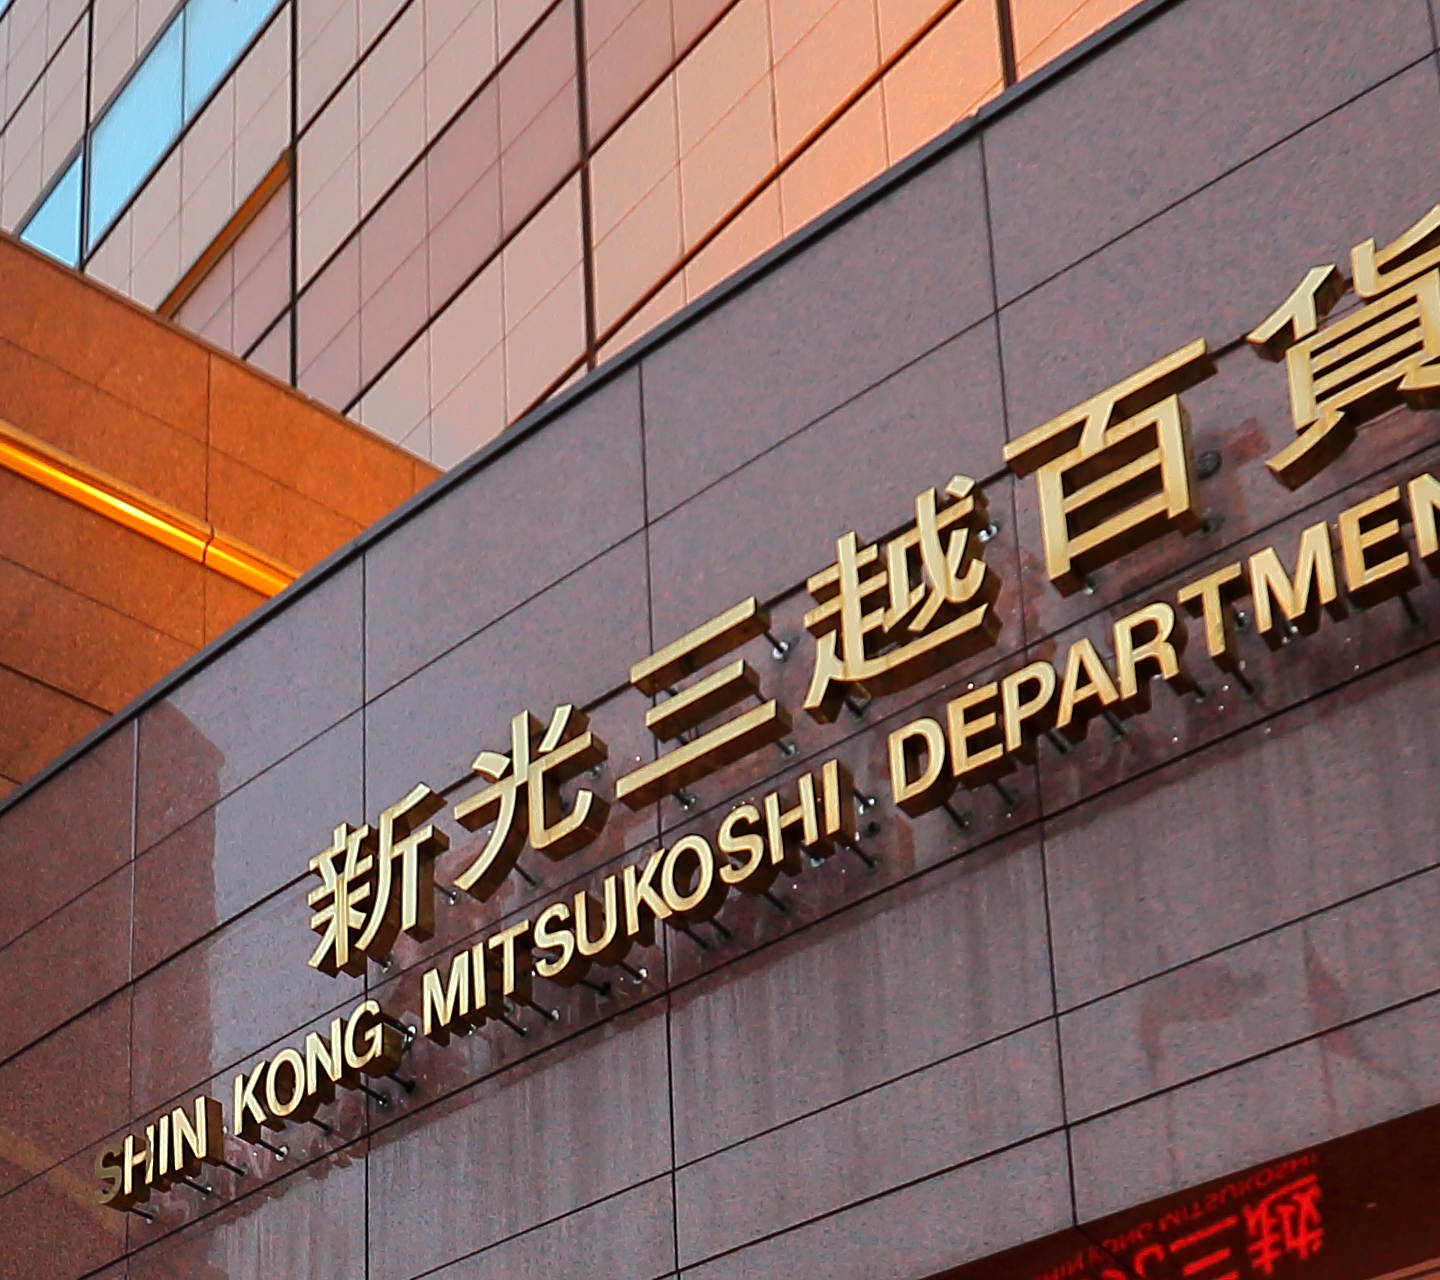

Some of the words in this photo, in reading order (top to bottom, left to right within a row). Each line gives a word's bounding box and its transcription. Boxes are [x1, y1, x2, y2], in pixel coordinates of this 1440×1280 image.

[93, 1094, 220, 1210] SHIN
[232, 999, 395, 1140] KONG
[421, 758, 852, 1042] MITSUKOSHI
